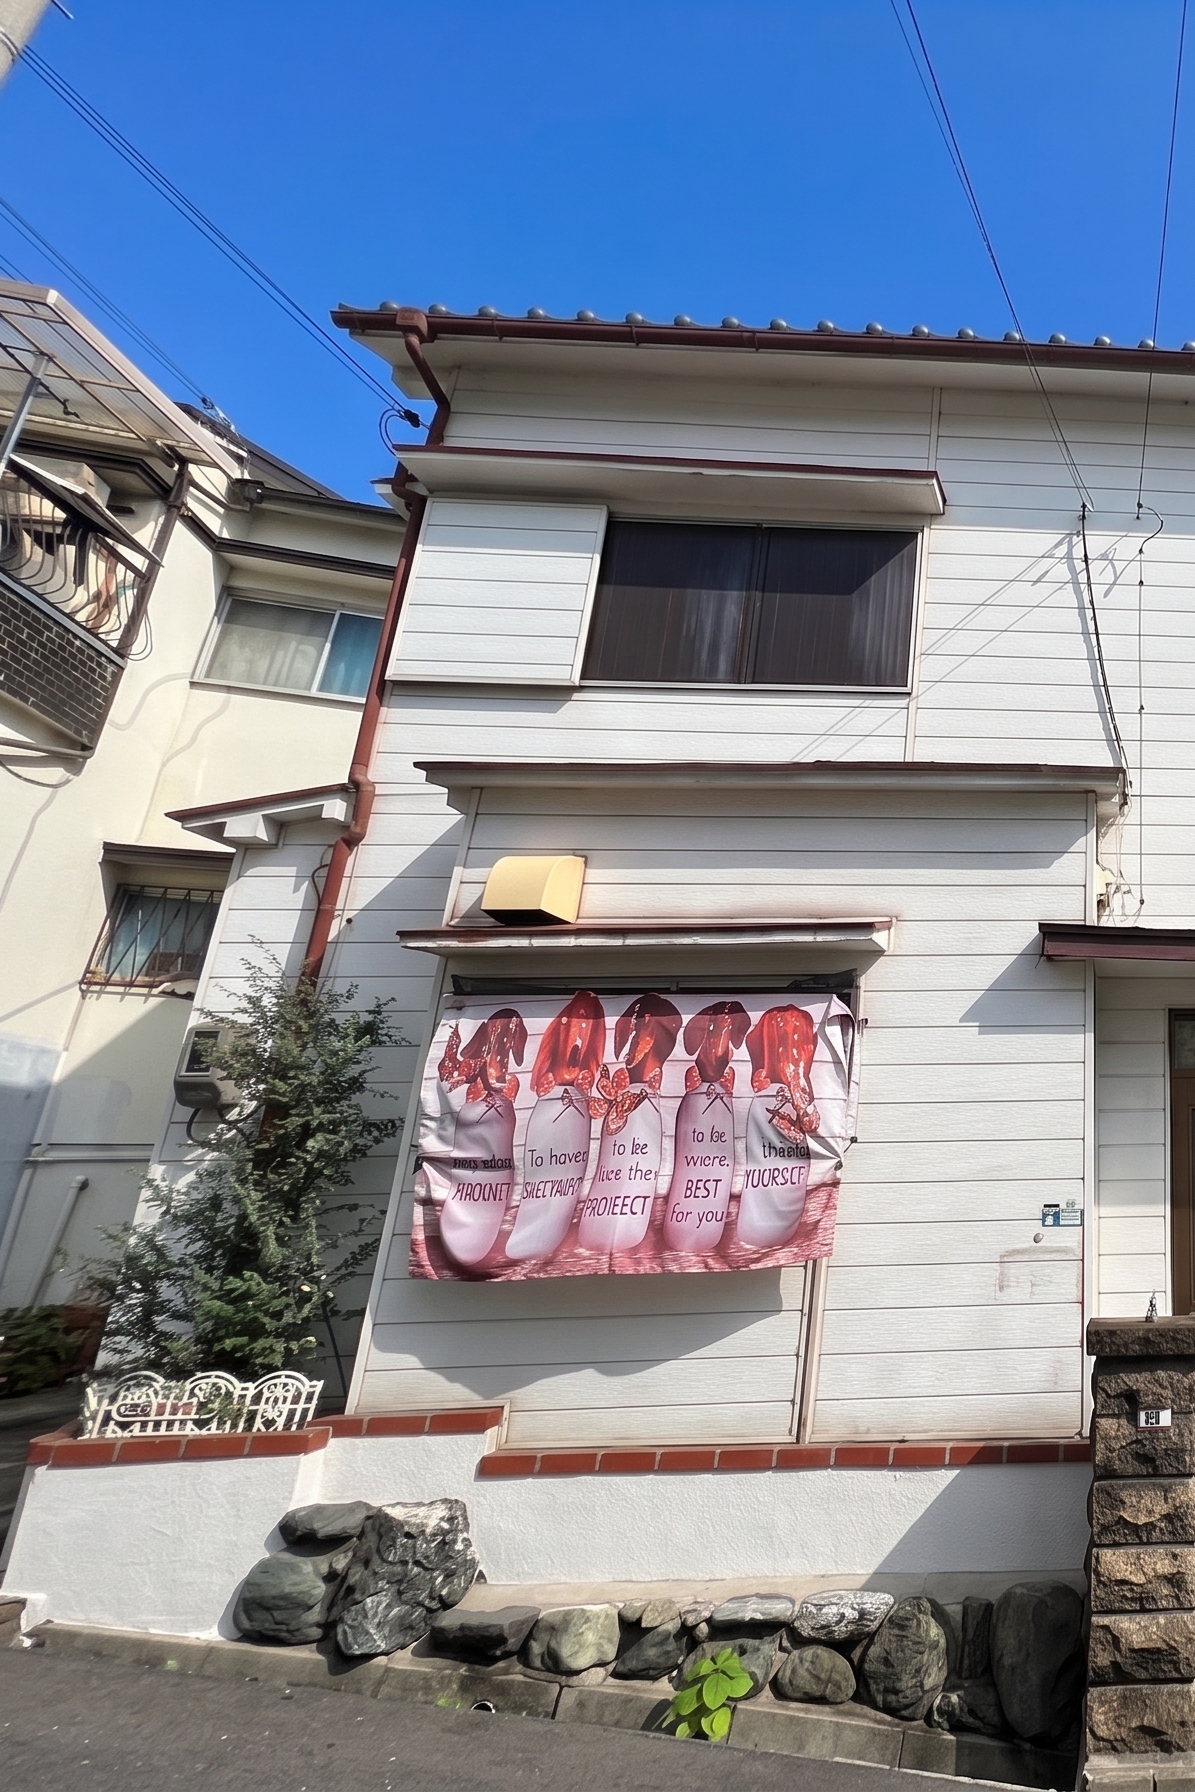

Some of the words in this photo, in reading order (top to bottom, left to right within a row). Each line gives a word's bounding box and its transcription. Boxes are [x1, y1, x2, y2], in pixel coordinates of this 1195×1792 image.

[692, 1128, 705, 1143] to
[612, 1139, 626, 1157] to
[527, 1149, 544, 1168] To
[683, 1178, 723, 1199] BEST
[670, 1202, 692, 1223] for
[695, 1210, 725, 1229] you
